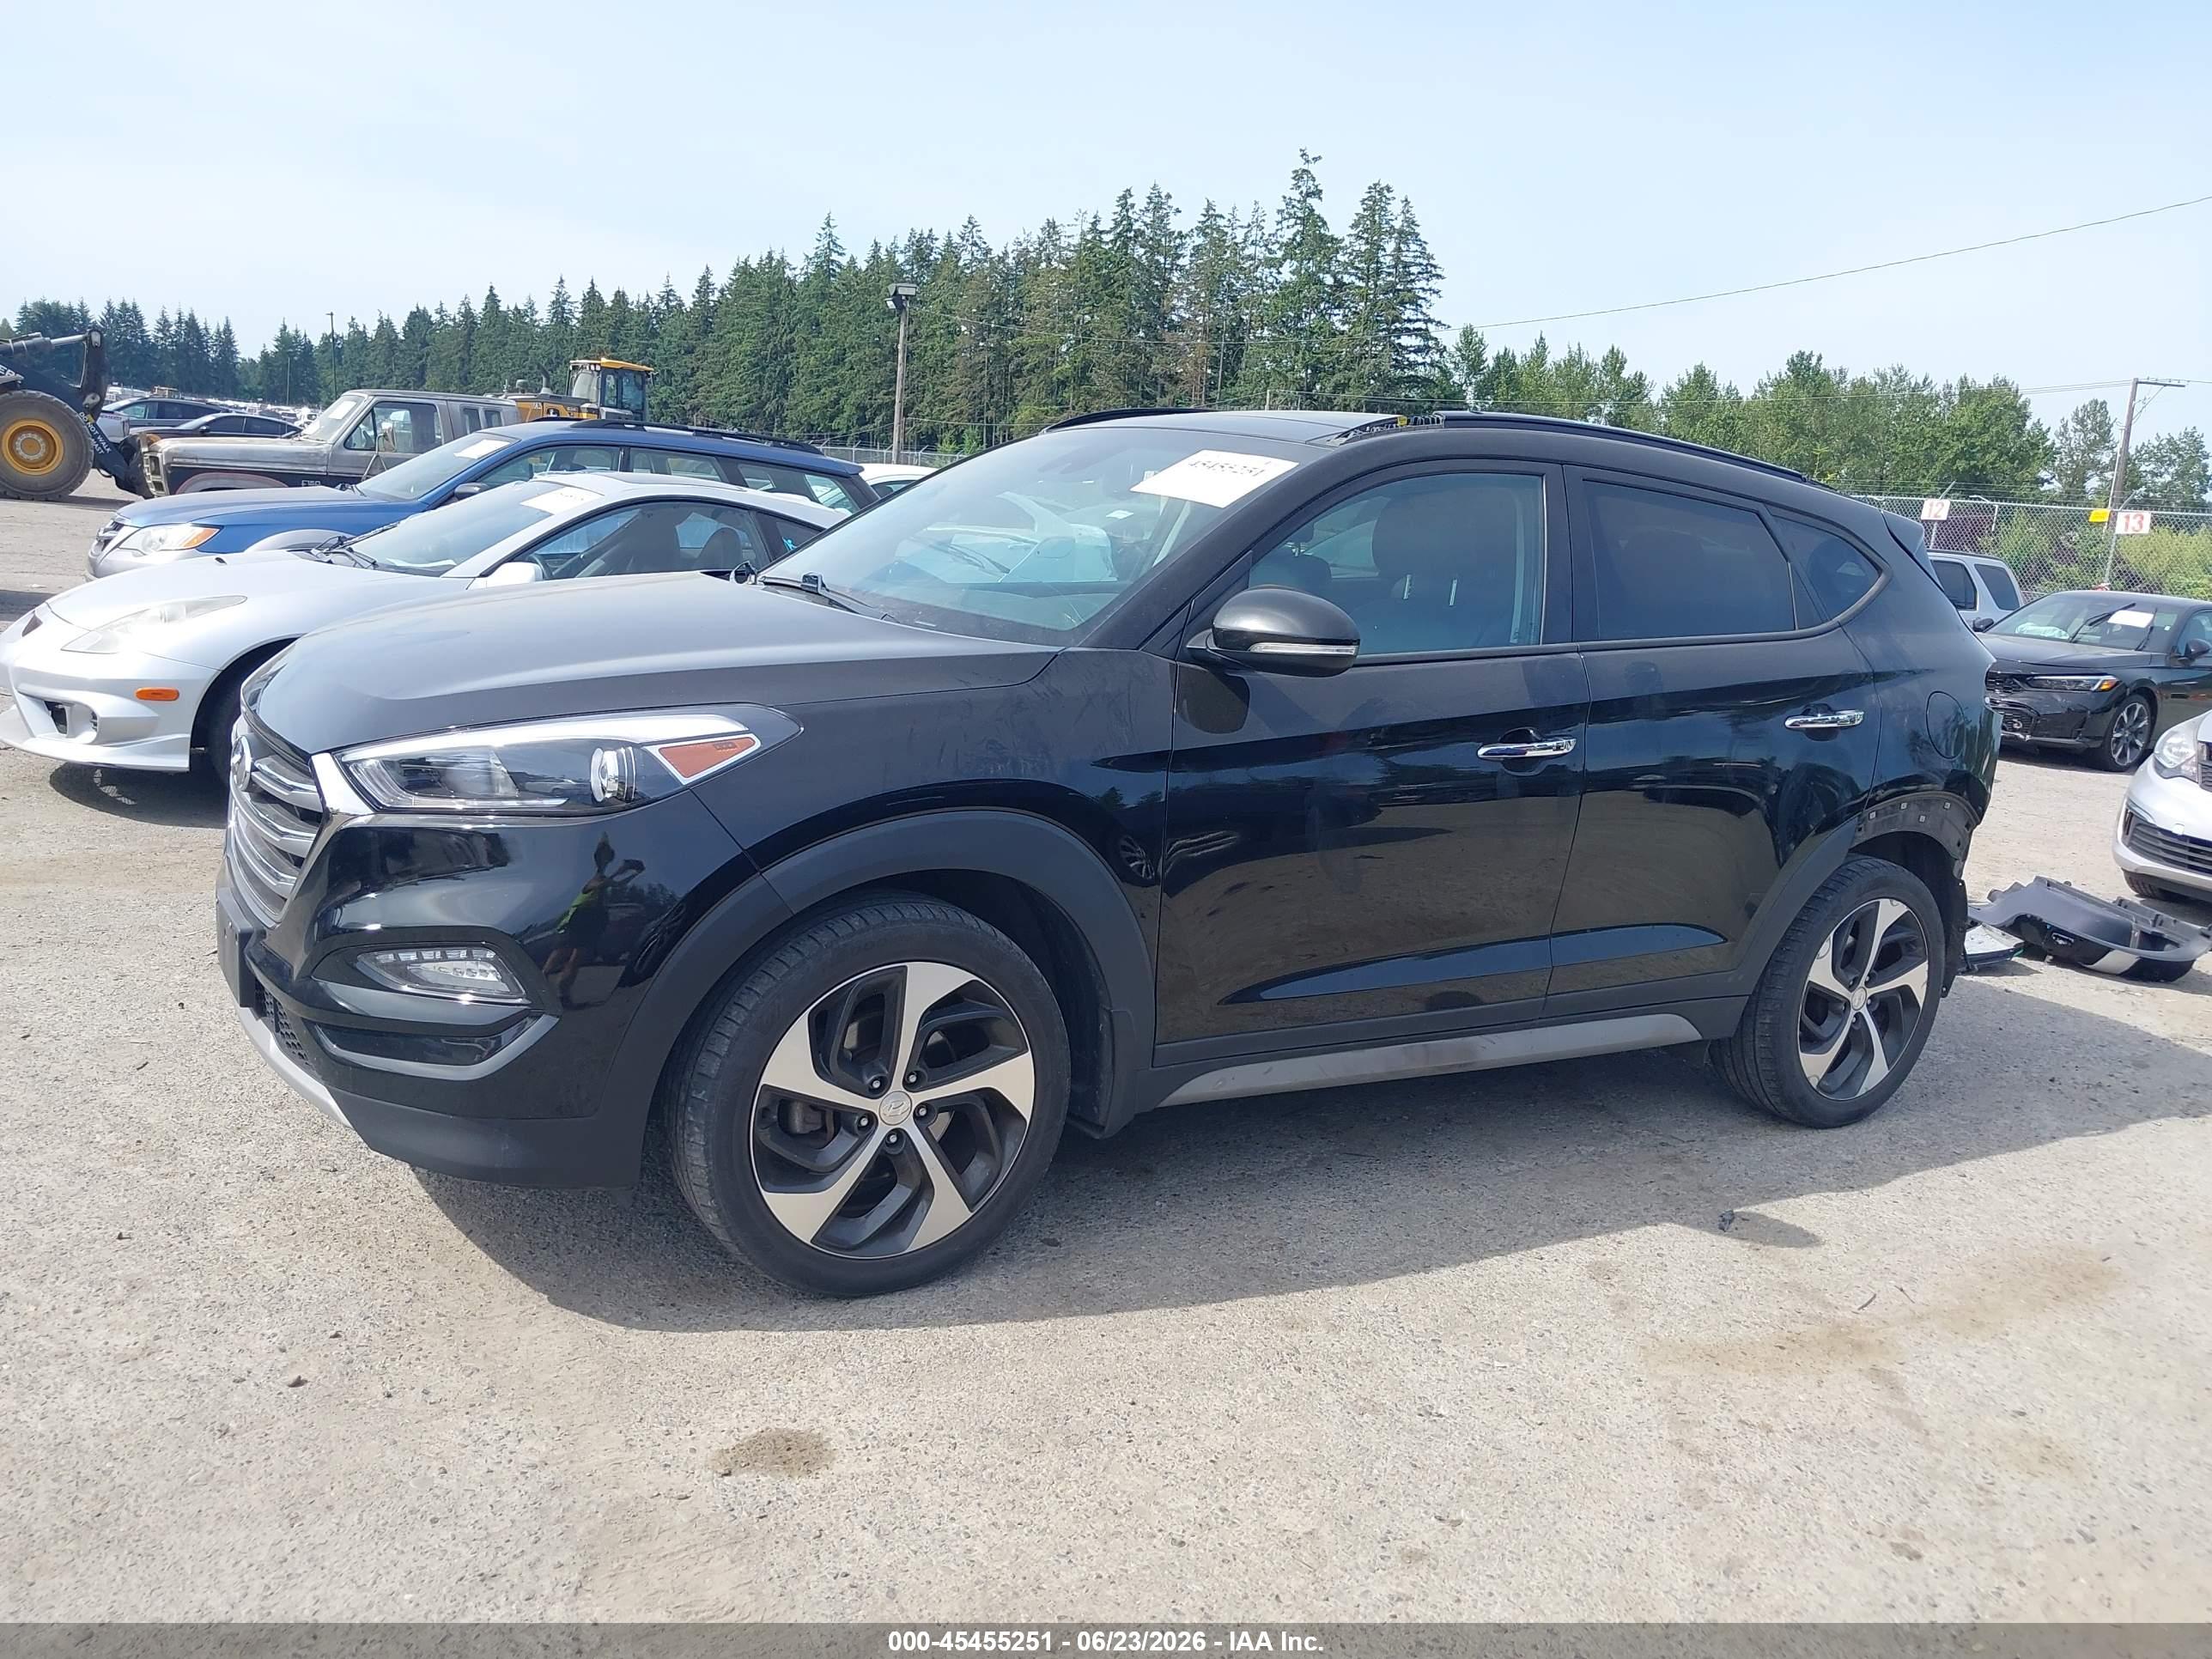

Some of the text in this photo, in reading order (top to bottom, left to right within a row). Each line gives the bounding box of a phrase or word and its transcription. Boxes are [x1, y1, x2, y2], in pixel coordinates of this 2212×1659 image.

[78, 411, 112, 453] DO NOT WALK
[1927, 501, 1945, 519] 12
[2124, 513, 2144, 532] 13
